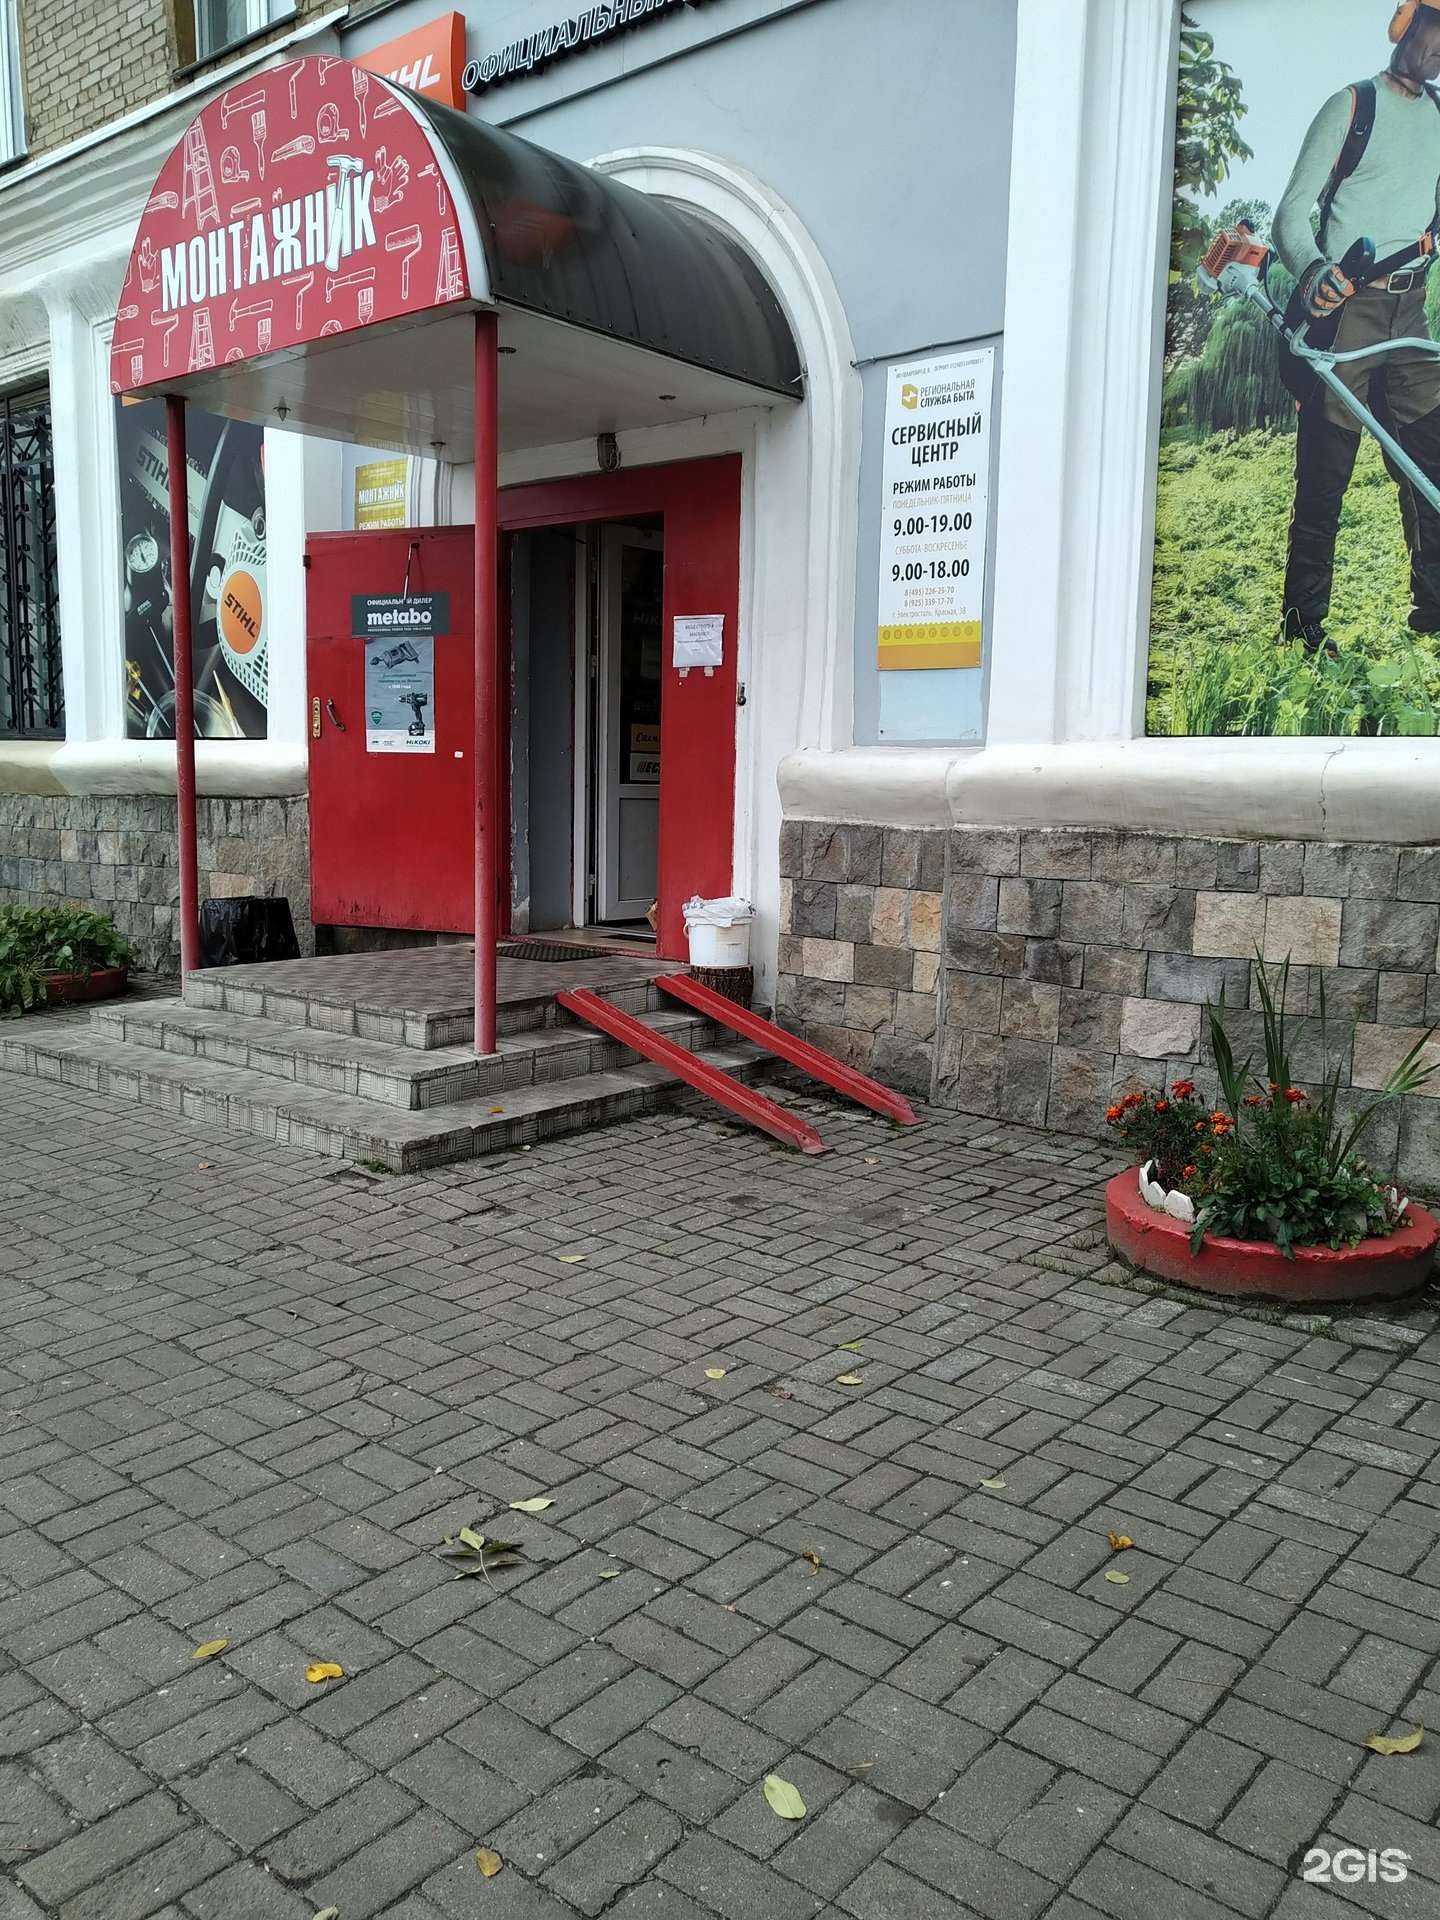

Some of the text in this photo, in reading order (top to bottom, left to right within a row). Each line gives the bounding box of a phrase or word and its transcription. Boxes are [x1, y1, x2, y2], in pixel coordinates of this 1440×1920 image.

[461, 0, 672, 91] ОФИЦИАЛЬНЫ
[160, 170, 376, 312] МОНТАЖНИК
[920, 378, 976, 397] РЕГИОНАЛЬНАЯ
[920, 390, 975, 408] СЛУЖБА БЫТА
[891, 411, 982, 446] СЕРВИСНЫЙ
[911, 441, 959, 467] ЦЕНТР
[136, 445, 169, 491] STIH
[359, 480, 405, 505] МОНТАЖНИК
[893, 473, 976, 495] РЕЖИМ РАБОТЫ
[893, 512, 973, 537] 9.00-19.00
[892, 559, 970, 582] 9.00-18.00
[413, 597, 433, 605] ДИЛЕР
[224, 593, 258, 638] STIHL
[367, 608, 432, 626] metabo
